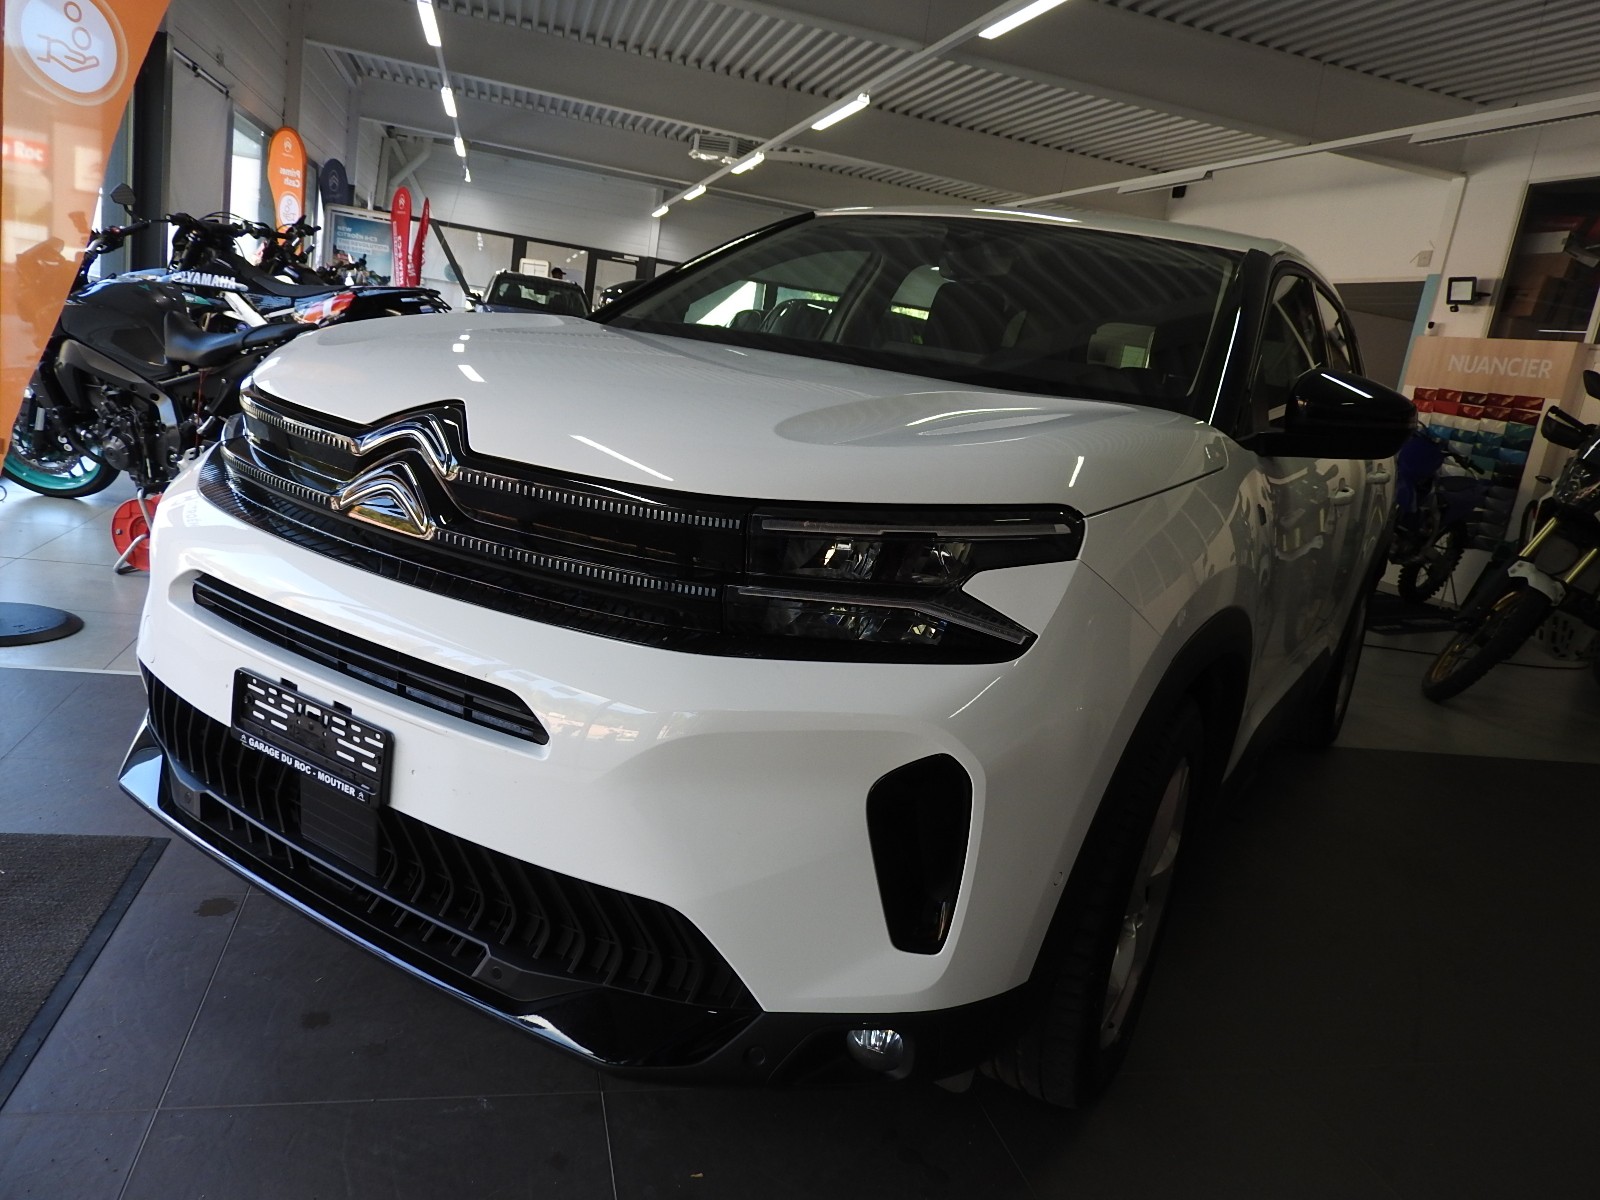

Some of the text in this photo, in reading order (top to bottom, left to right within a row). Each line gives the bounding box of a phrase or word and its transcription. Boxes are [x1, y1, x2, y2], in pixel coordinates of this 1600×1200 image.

[187, 271, 236, 289] YAMAHA
[1447, 354, 1553, 379] NUANCIER
[248, 737, 280, 760] GARAGE
[281, 753, 293, 766] DU
[294, 759, 312, 775] ROC
[317, 770, 356, 797] MOUTIER
